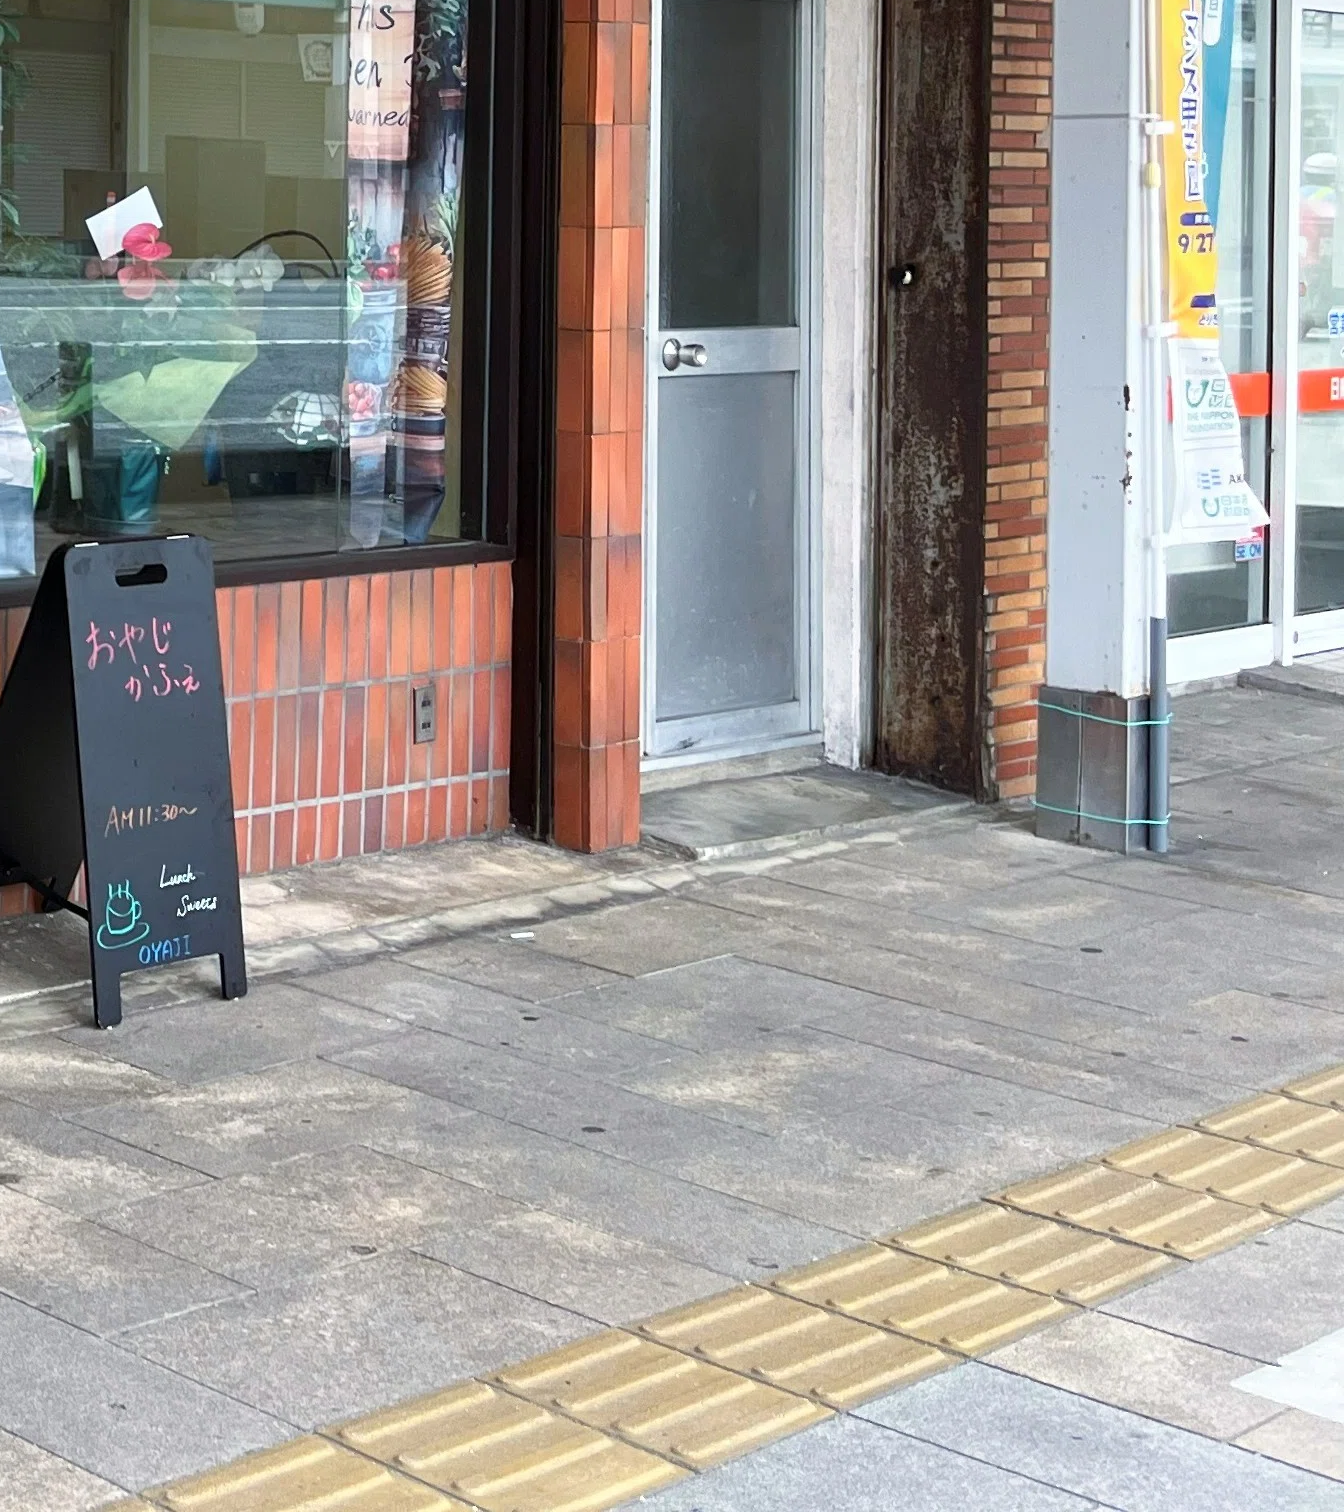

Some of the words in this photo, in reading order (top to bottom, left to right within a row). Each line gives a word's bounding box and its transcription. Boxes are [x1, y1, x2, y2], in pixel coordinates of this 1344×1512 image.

[85, 616, 171, 671] おやじ
[158, 864, 197, 889] Lunch
[138, 934, 192, 965] OYAJI
